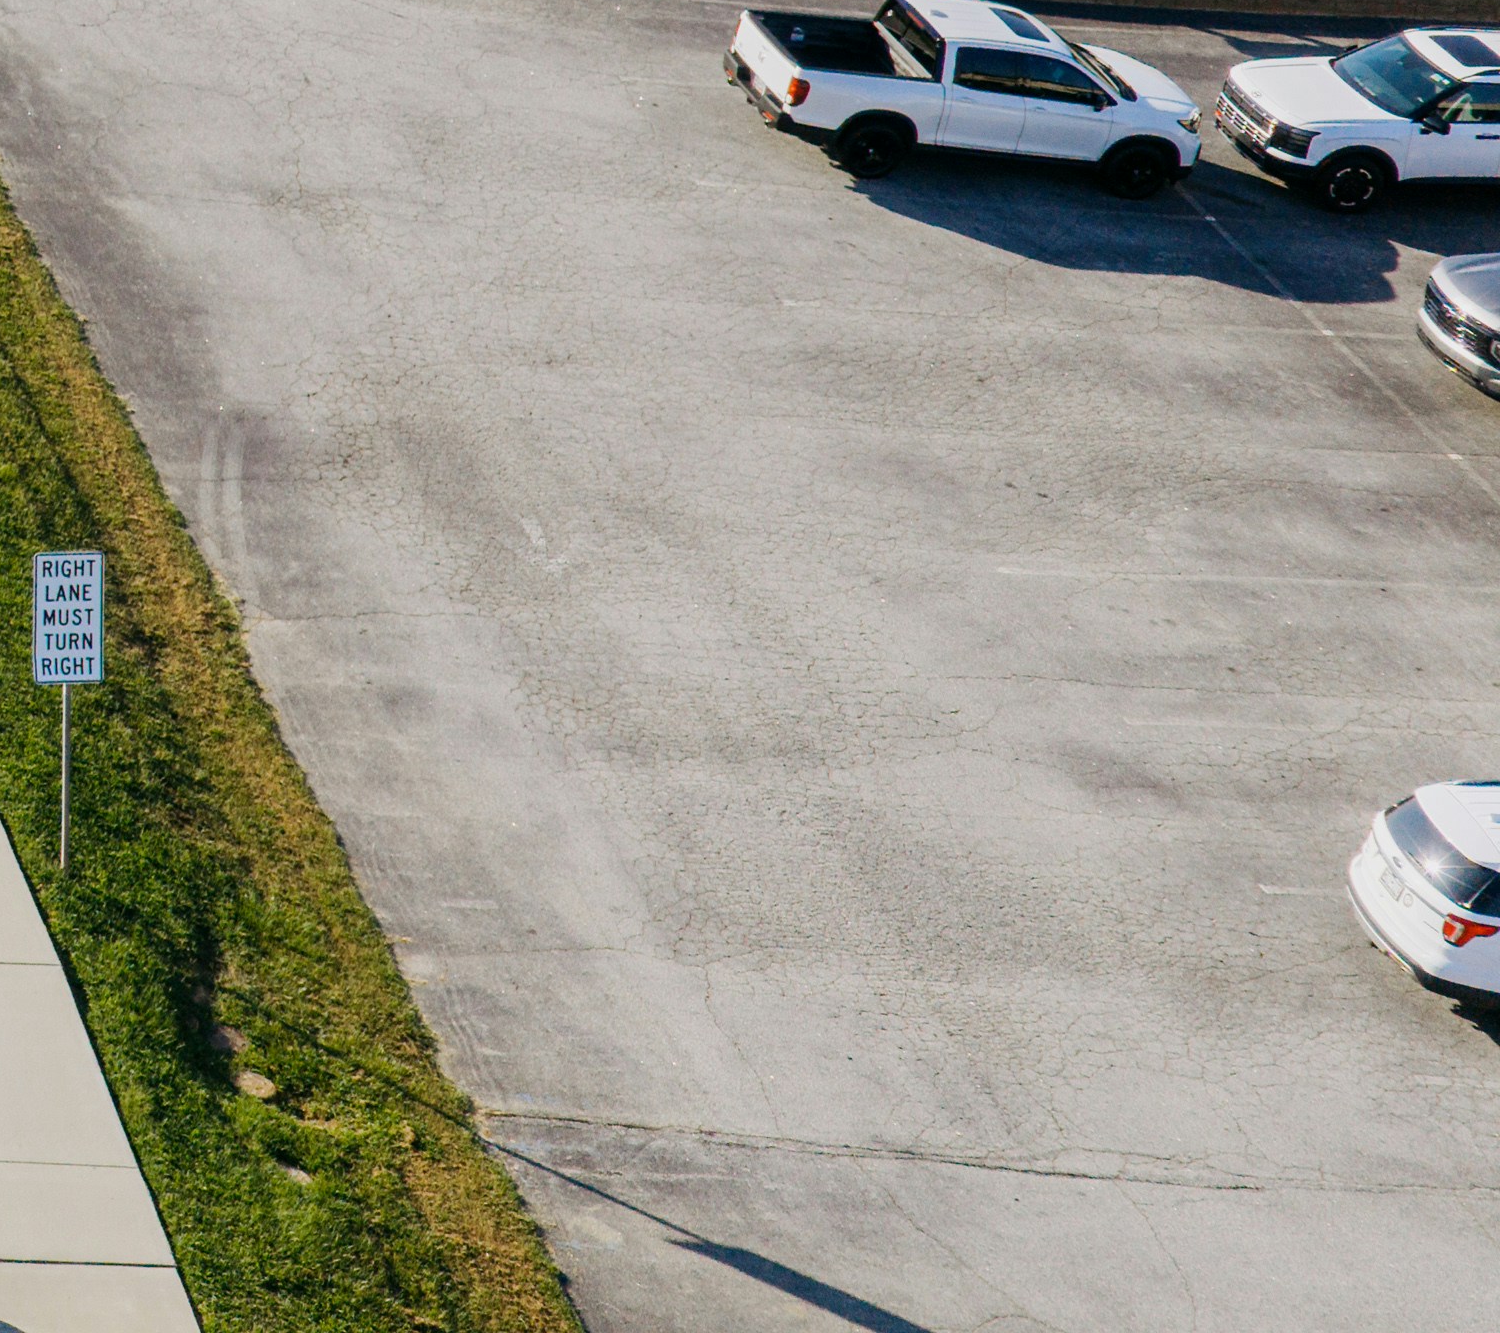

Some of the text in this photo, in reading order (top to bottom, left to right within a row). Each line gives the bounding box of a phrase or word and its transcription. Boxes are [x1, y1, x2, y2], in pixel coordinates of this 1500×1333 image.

[42, 559, 96, 578] RIGHT
[45, 584, 92, 602] LANE
[43, 608, 95, 626] MUST
[44, 633, 93, 651] TURN
[41, 657, 96, 675] RIGHT
